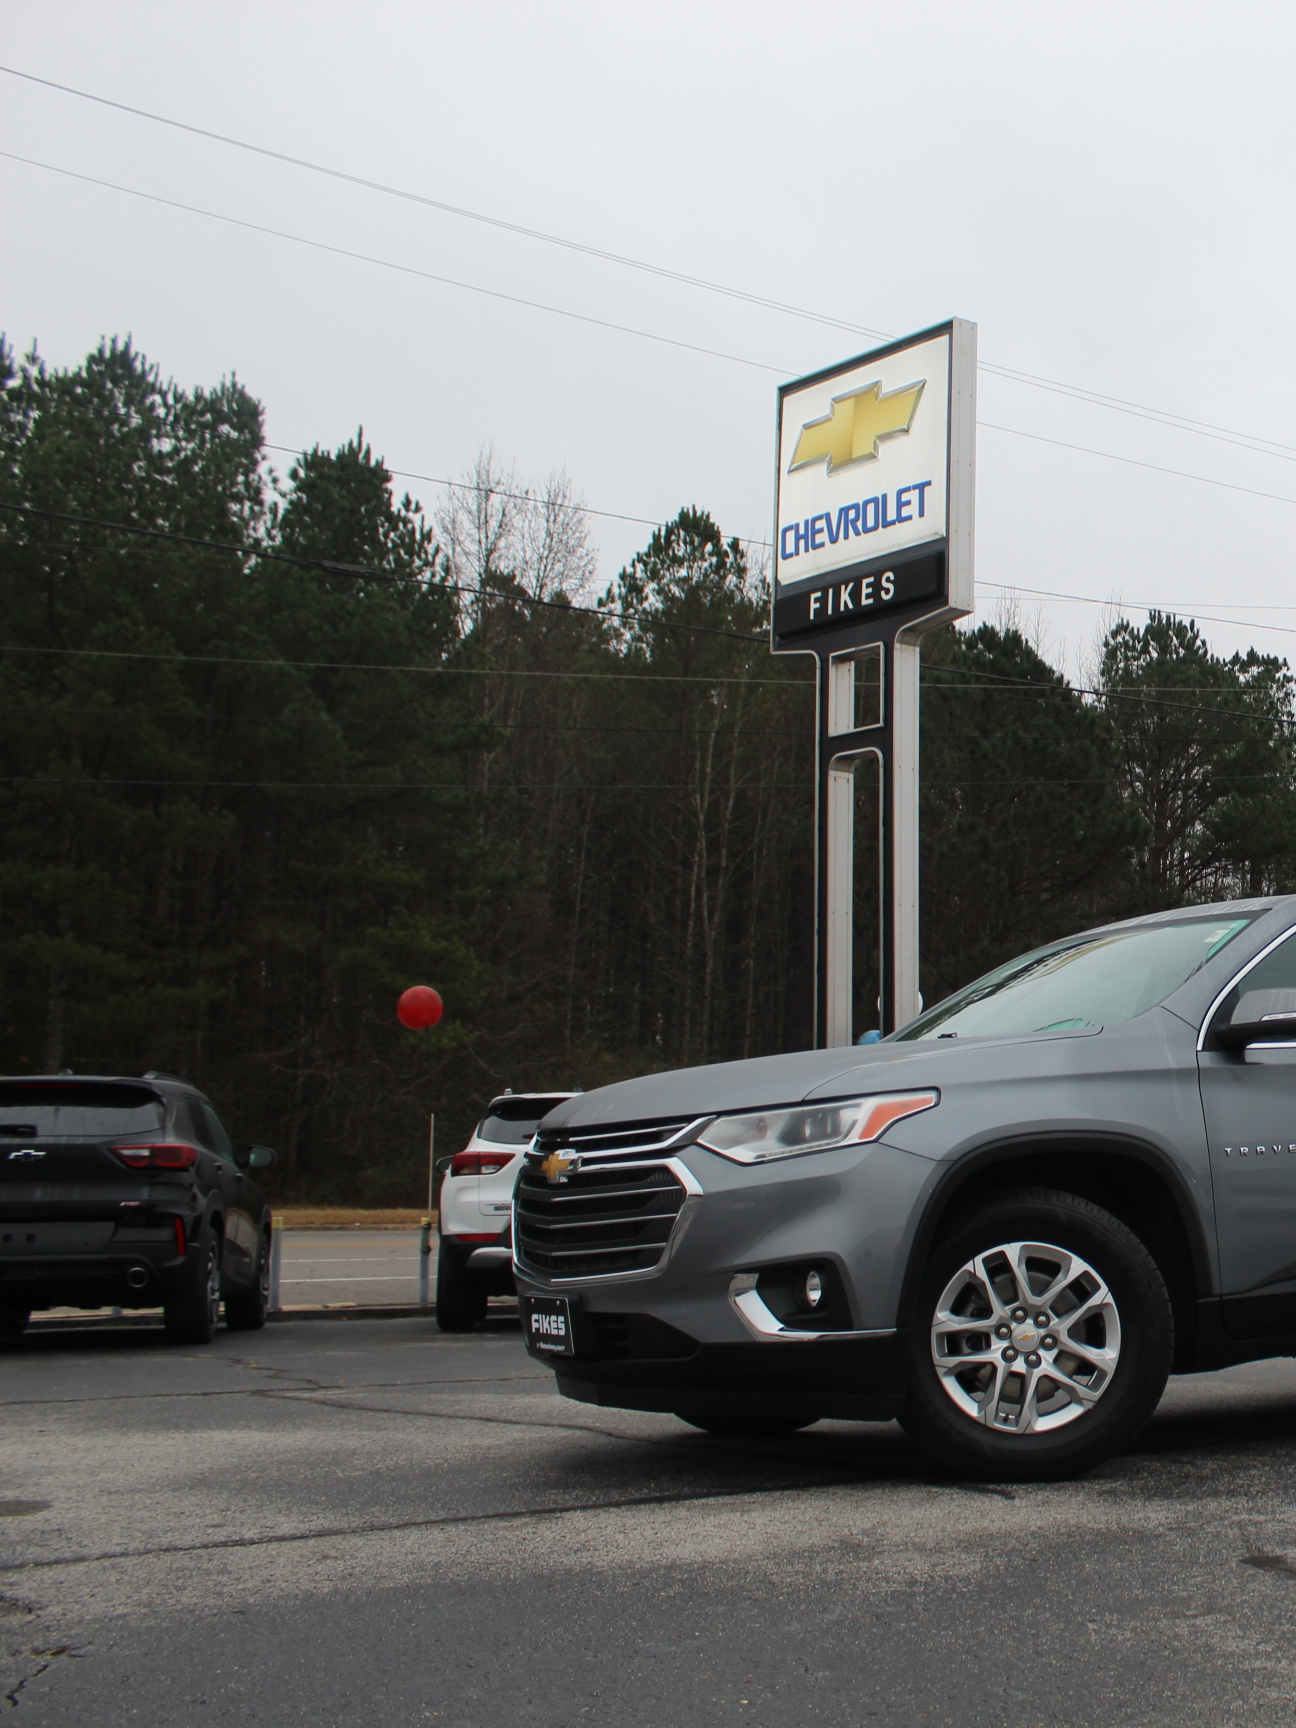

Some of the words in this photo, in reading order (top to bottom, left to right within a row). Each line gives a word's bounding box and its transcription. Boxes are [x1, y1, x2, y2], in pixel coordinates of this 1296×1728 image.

[780, 479, 932, 560] CHEVROLET
[809, 571, 895, 620] FIKES
[531, 1313, 566, 1335] FIKES
